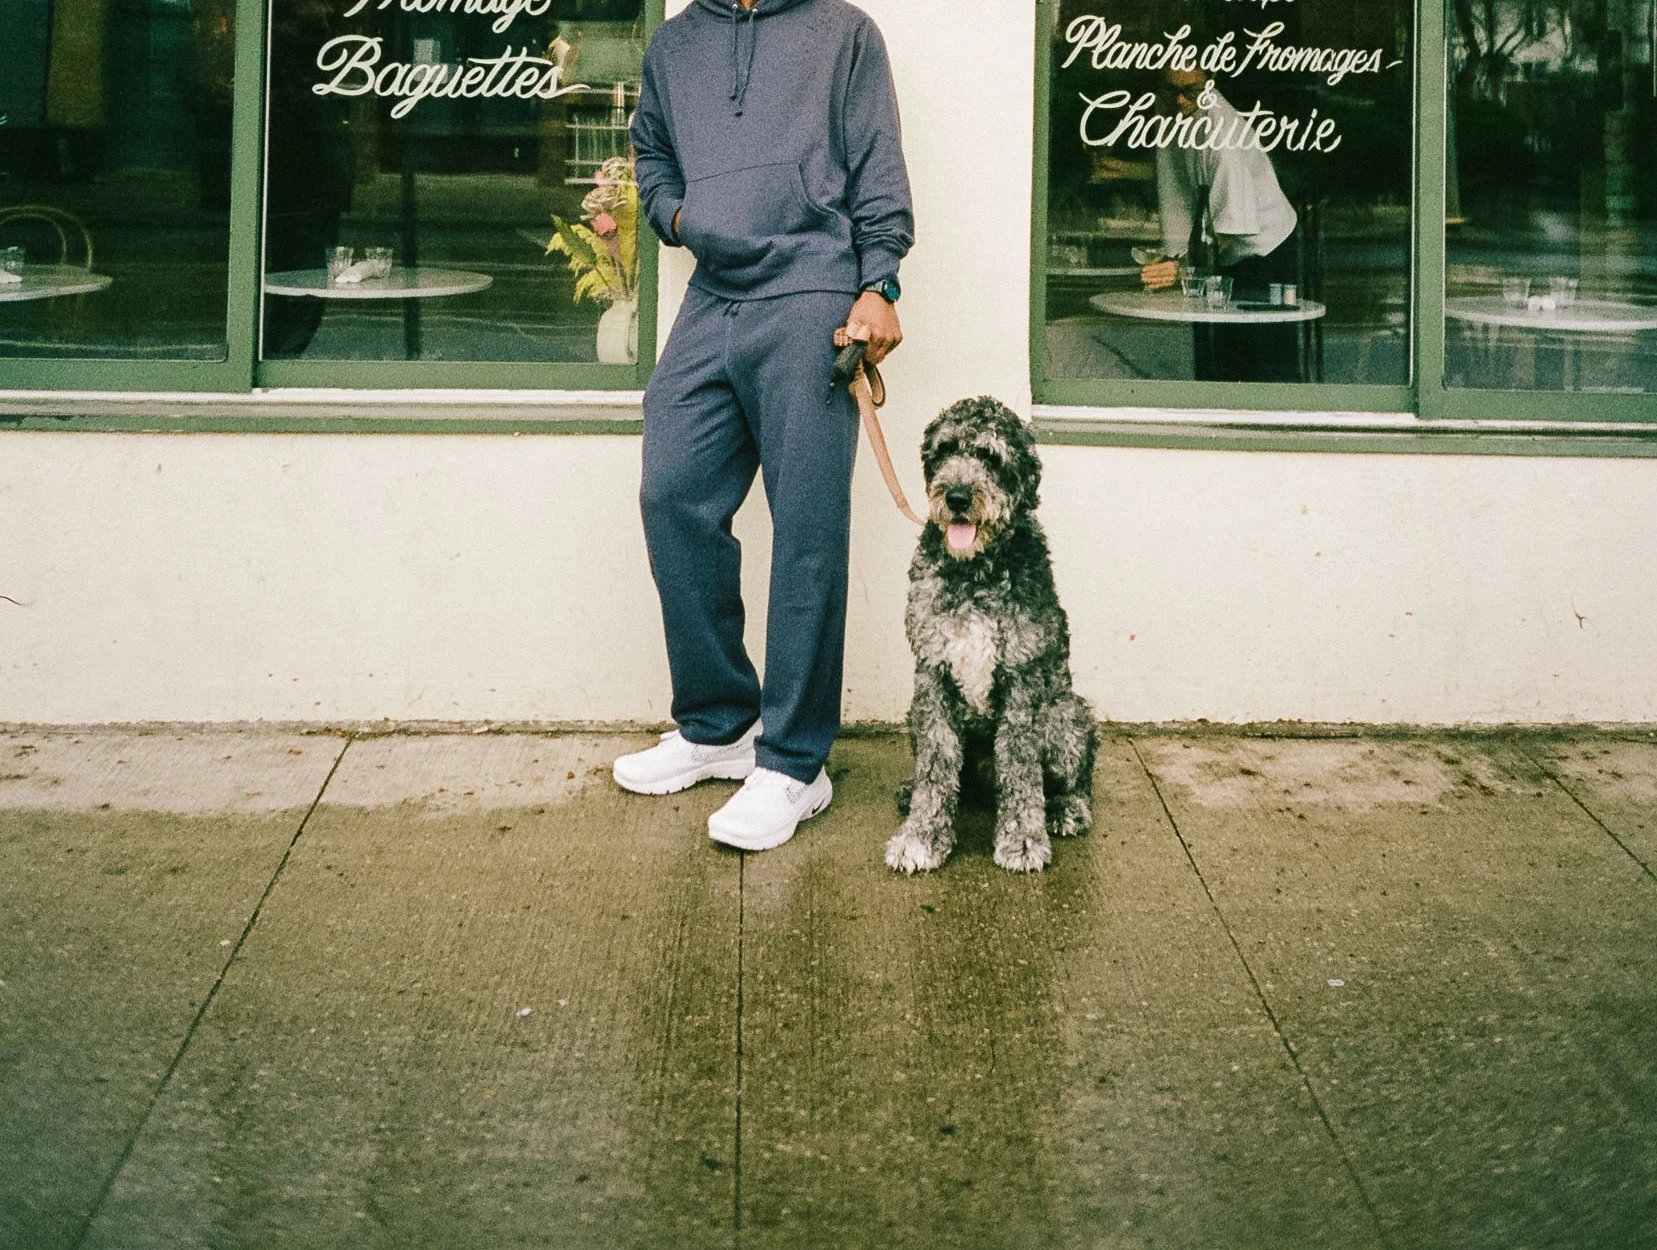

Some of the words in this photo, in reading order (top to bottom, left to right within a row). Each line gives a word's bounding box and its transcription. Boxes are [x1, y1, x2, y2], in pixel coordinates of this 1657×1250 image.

[1061, 14, 1197, 73] Planche
[1199, 30, 1237, 73] de
[312, 34, 591, 119] Baguettes
[1195, 78, 1222, 111] &
[1078, 89, 1343, 153] Charcuterie
